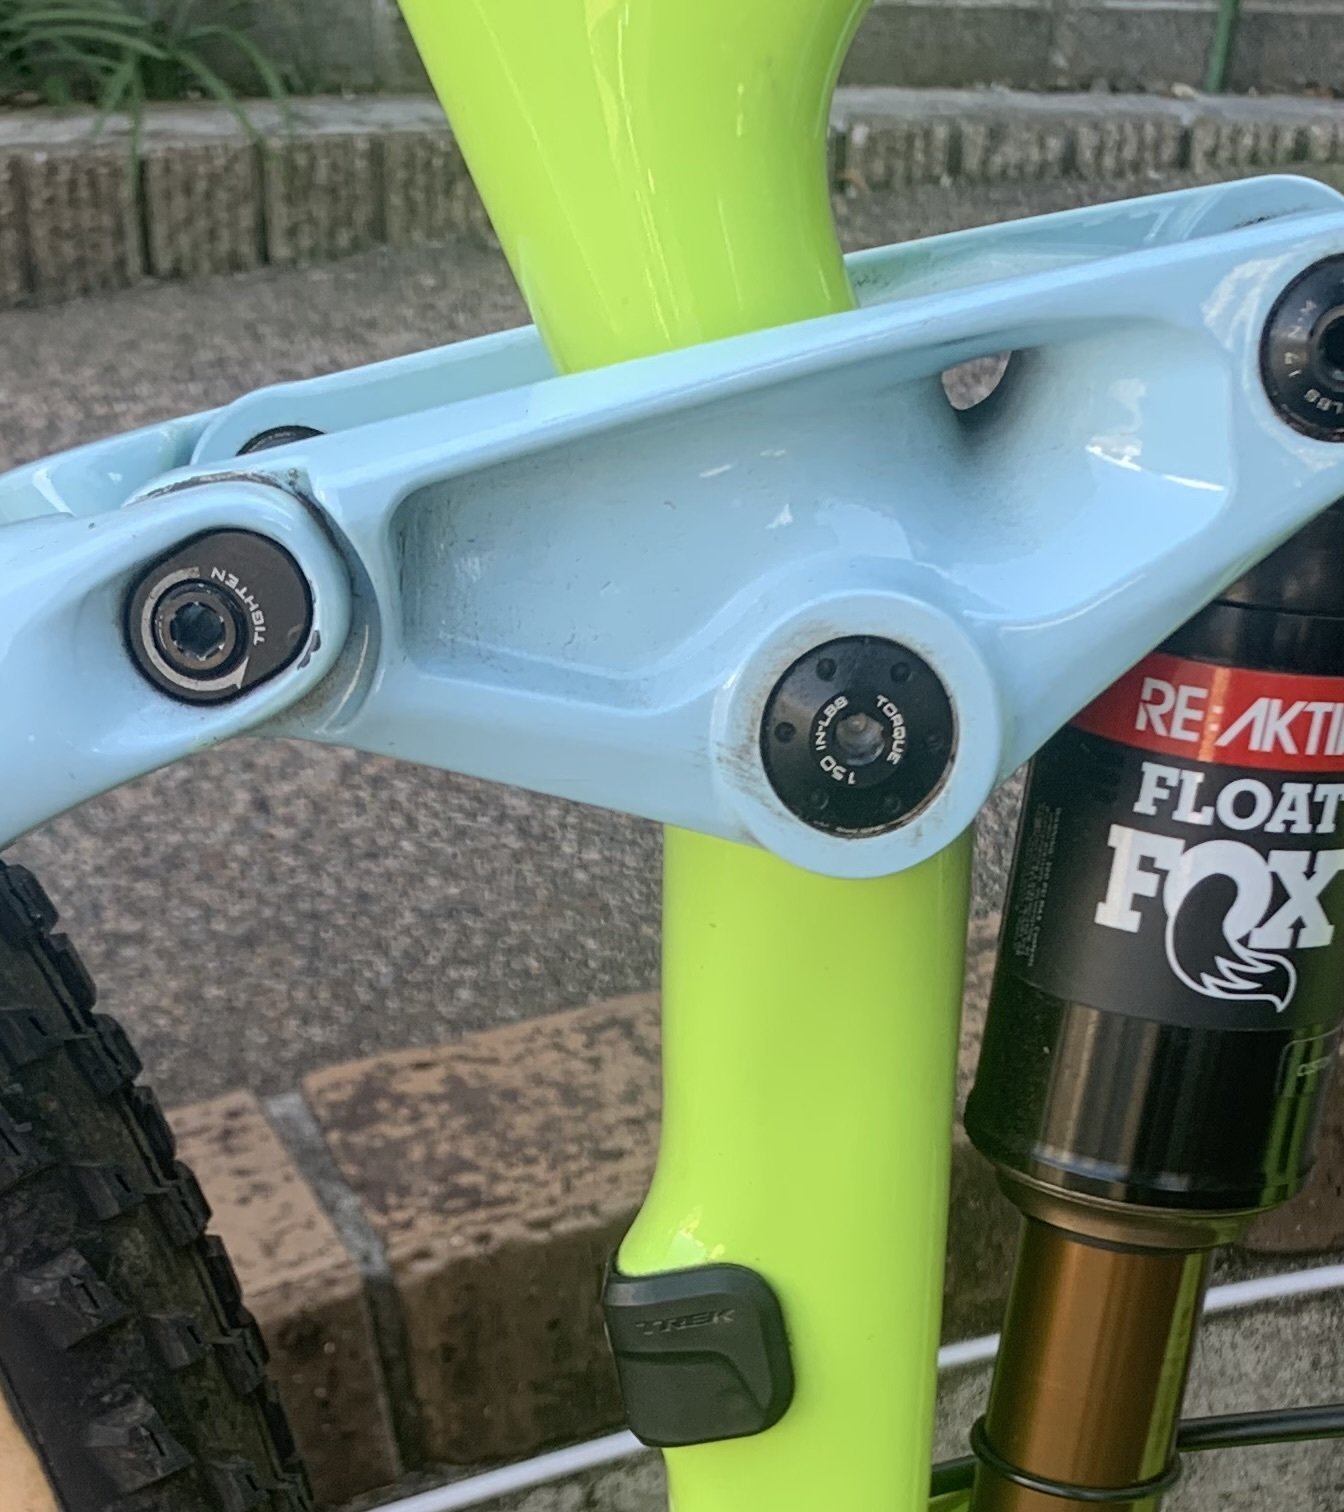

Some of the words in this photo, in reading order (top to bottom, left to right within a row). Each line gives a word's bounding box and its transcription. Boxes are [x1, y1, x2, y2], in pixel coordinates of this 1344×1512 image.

[210, 566, 266, 646] TIGHTEN
[815, 695, 849, 751] IN-LBS
[876, 694, 905, 765] TORQUE
[819, 755, 856, 785] 150
[636, 1309, 736, 1336] TREK
